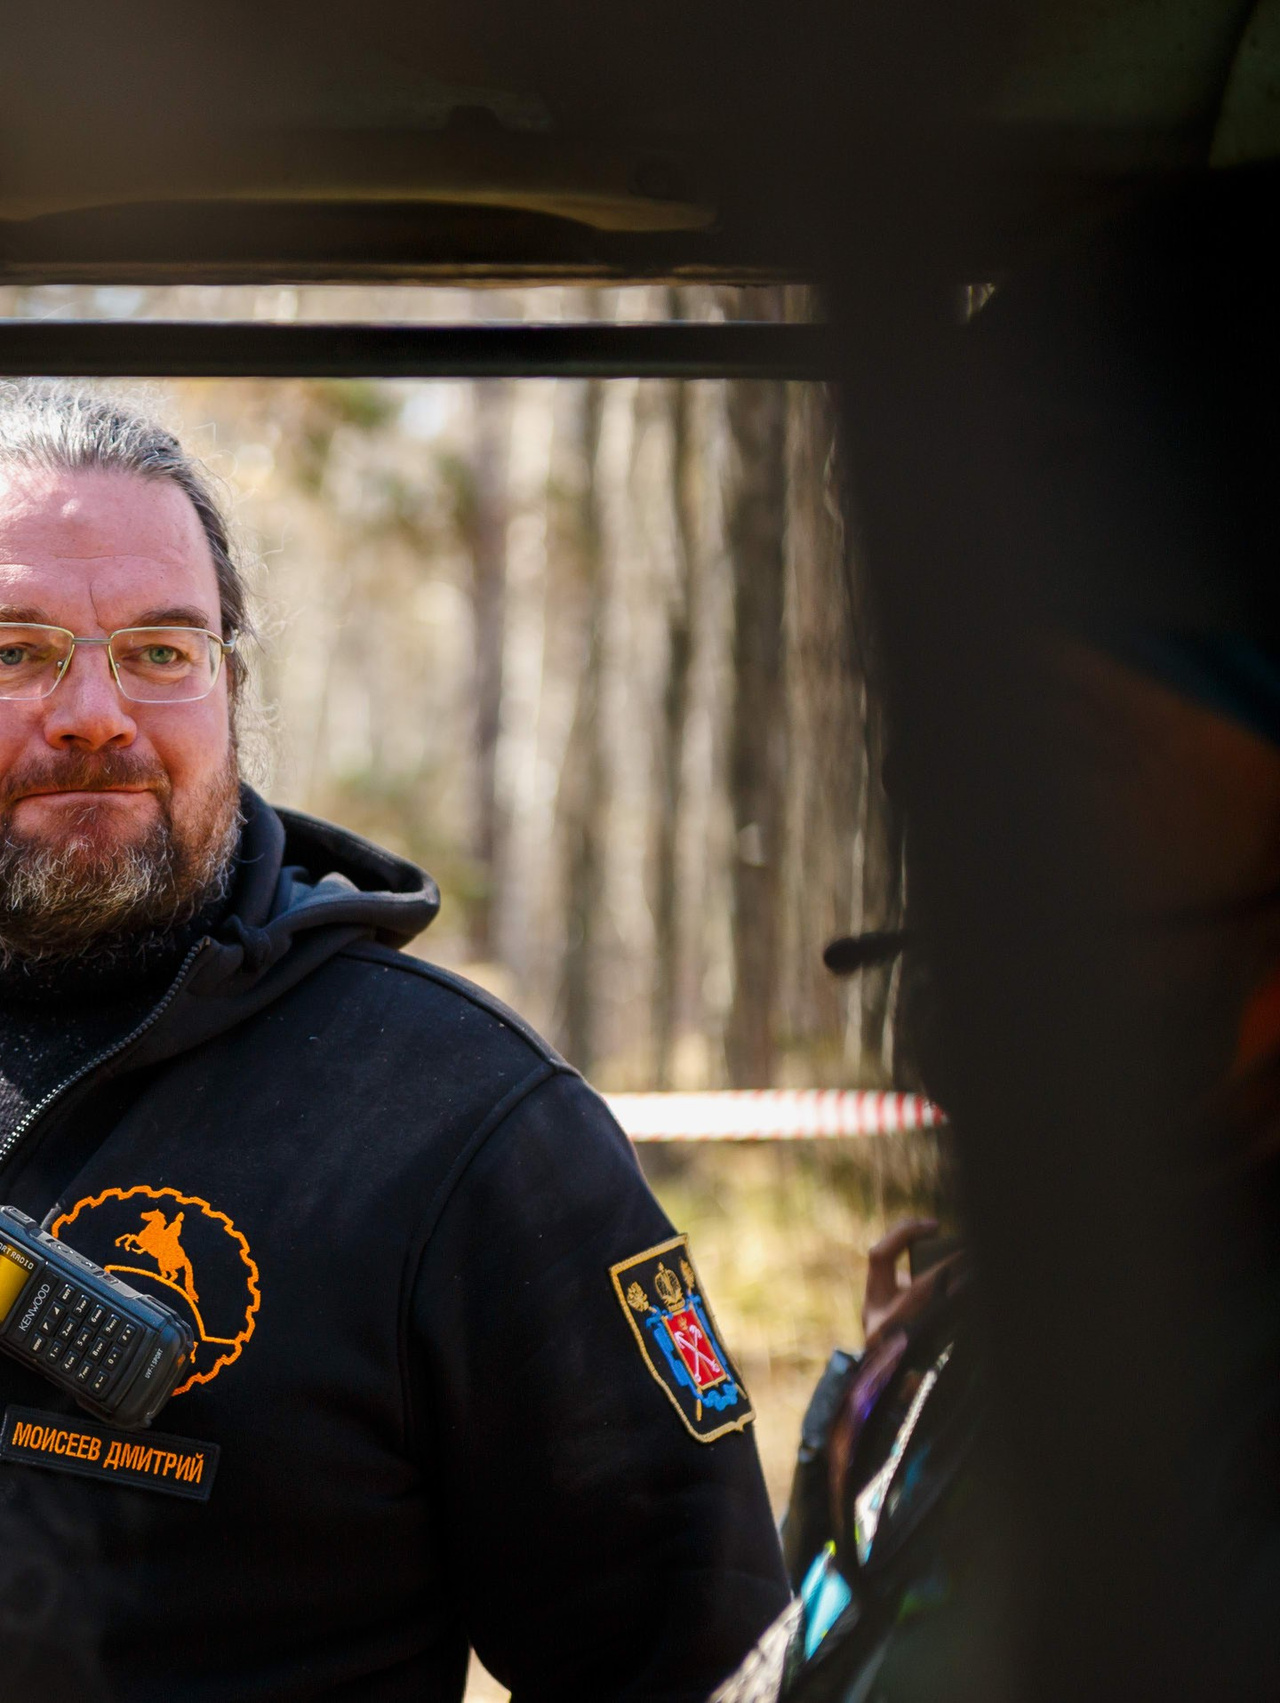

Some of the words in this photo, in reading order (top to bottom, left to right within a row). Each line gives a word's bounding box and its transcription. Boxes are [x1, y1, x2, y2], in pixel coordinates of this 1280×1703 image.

[10, 1250, 34, 1270] RADIO
[18, 1283, 50, 1332] KENWOOD
[11, 1421, 102, 1462] МОИСЕЕВ
[102, 1441, 204, 1484] ДМИТРИЙ
